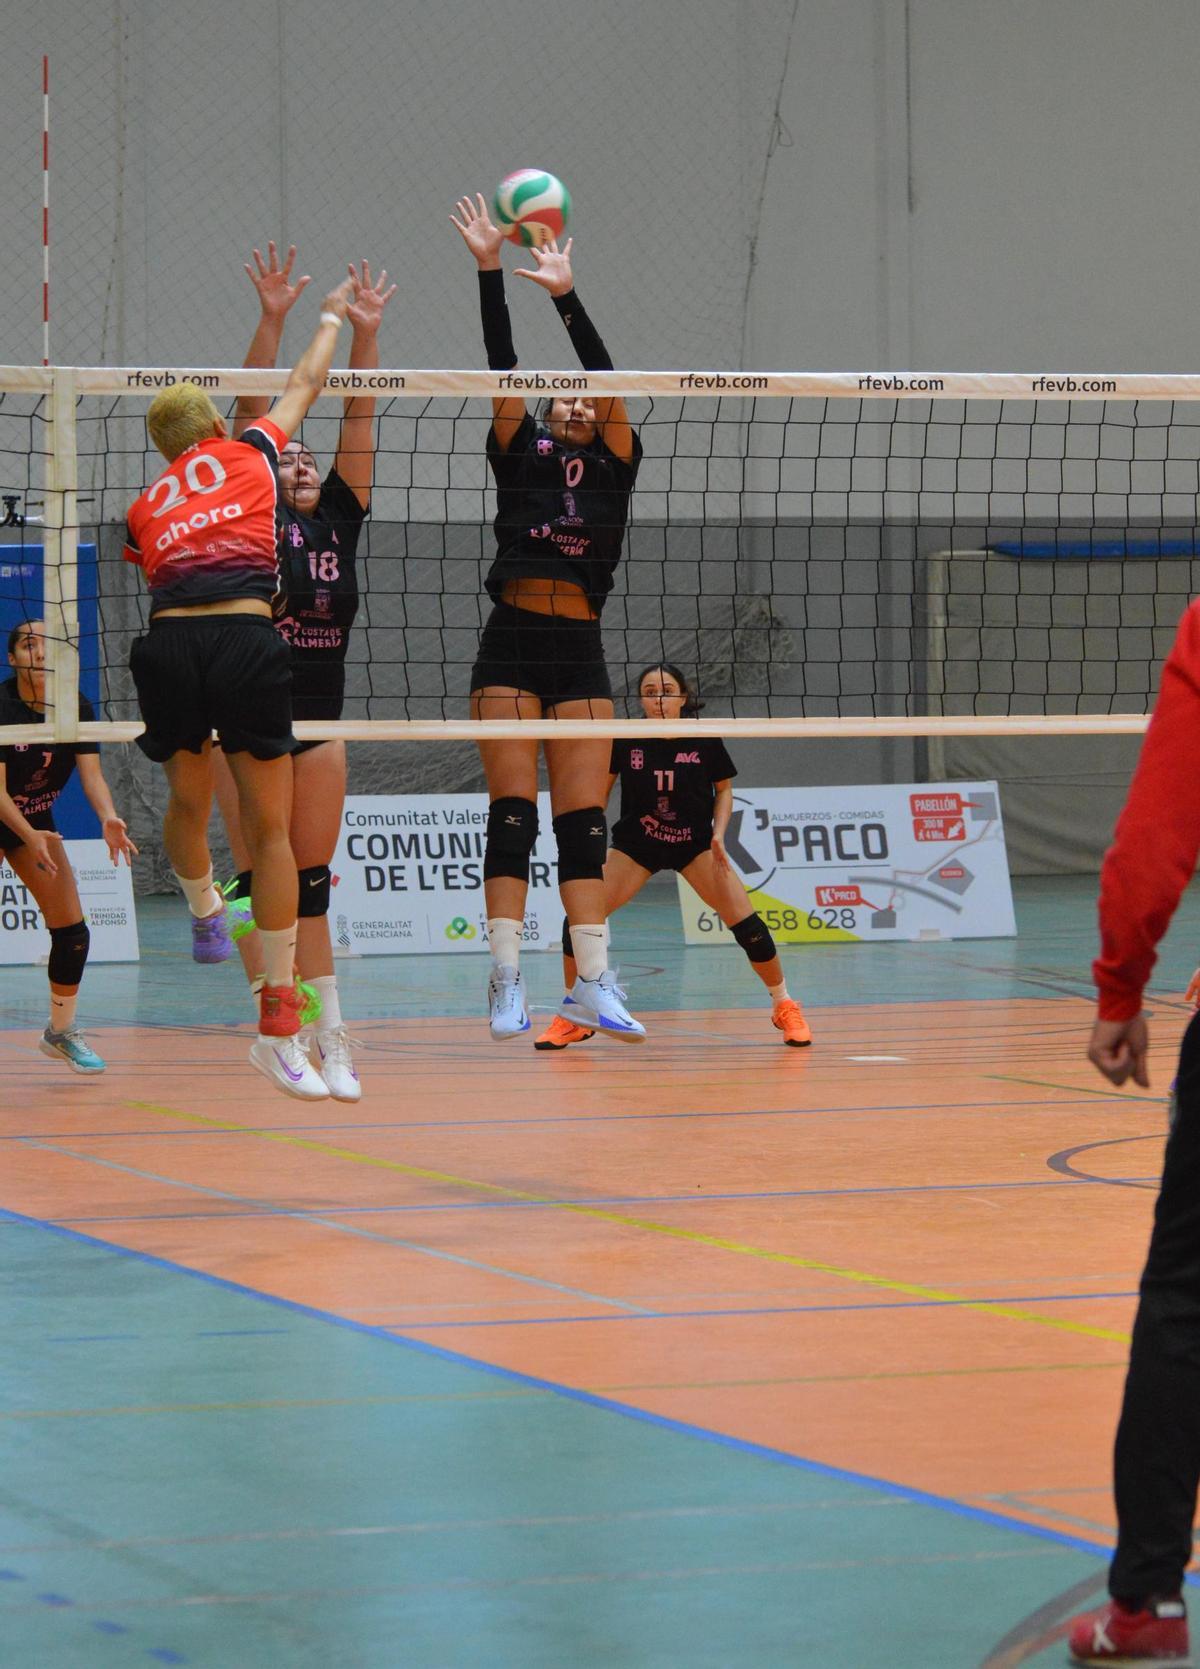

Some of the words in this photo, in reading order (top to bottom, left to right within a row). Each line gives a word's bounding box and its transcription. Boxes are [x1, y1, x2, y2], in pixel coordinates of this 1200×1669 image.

[127, 371, 219, 386] rfevbcom
[323, 372, 405, 388] fevb.com
[499, 374, 587, 389] rfevb.com
[680, 374, 768, 388] rfevb.com
[858, 376, 944, 390] rfevb.com
[1032, 377, 1116, 392] rfevb.com
[148, 454, 227, 518] 20
[156, 503, 244, 550] ahora
[308, 551, 339, 581] 18
[302, 628, 330, 637] COSTA
[42, 751, 53, 768] 7
[654, 770, 674, 791] 11
[24, 800, 54, 815] ALMER
[345, 810, 439, 827] Comunitat
[443, 809, 489, 826] Valen
[771, 812, 832, 821] ALMUERZOS
[839, 811, 885, 820] COMIDAS
[660, 825, 682, 835] COSTA
[347, 831, 541, 861] COMUNI
[364, 865, 408, 891] DE
[418, 862, 559, 891] L'ESR
[352, 920, 413, 930] GENERALITAT
[756, 909, 799, 931] 58
[807, 908, 857, 930] 628
[354, 930, 413, 939] VALENCIANA
